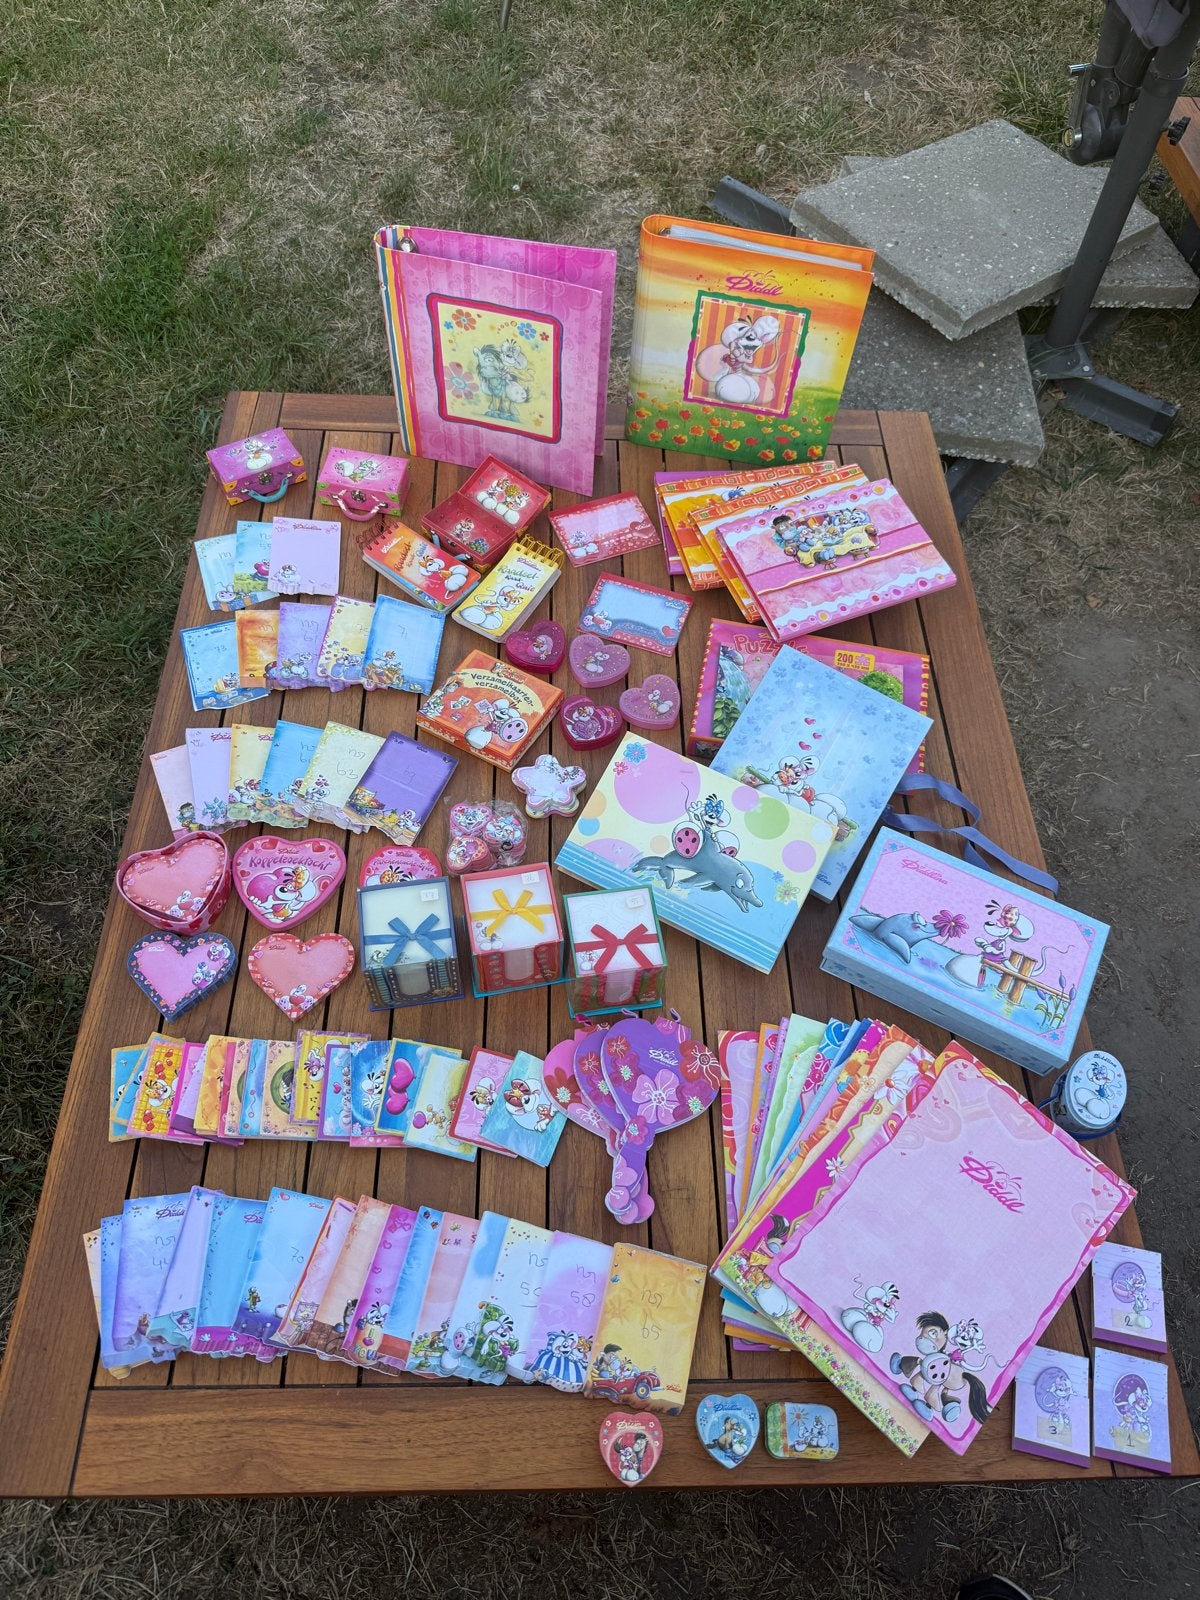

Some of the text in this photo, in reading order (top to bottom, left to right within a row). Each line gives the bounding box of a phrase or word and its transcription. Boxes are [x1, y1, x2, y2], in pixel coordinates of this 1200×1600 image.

[726, 272, 783, 296] Diddl
[837, 653, 853, 664] 200
[470, 672, 534, 707] Verzamelkaarten-
[1124, 1315, 1133, 1327] 2
[1050, 1425, 1058, 1435] 3
